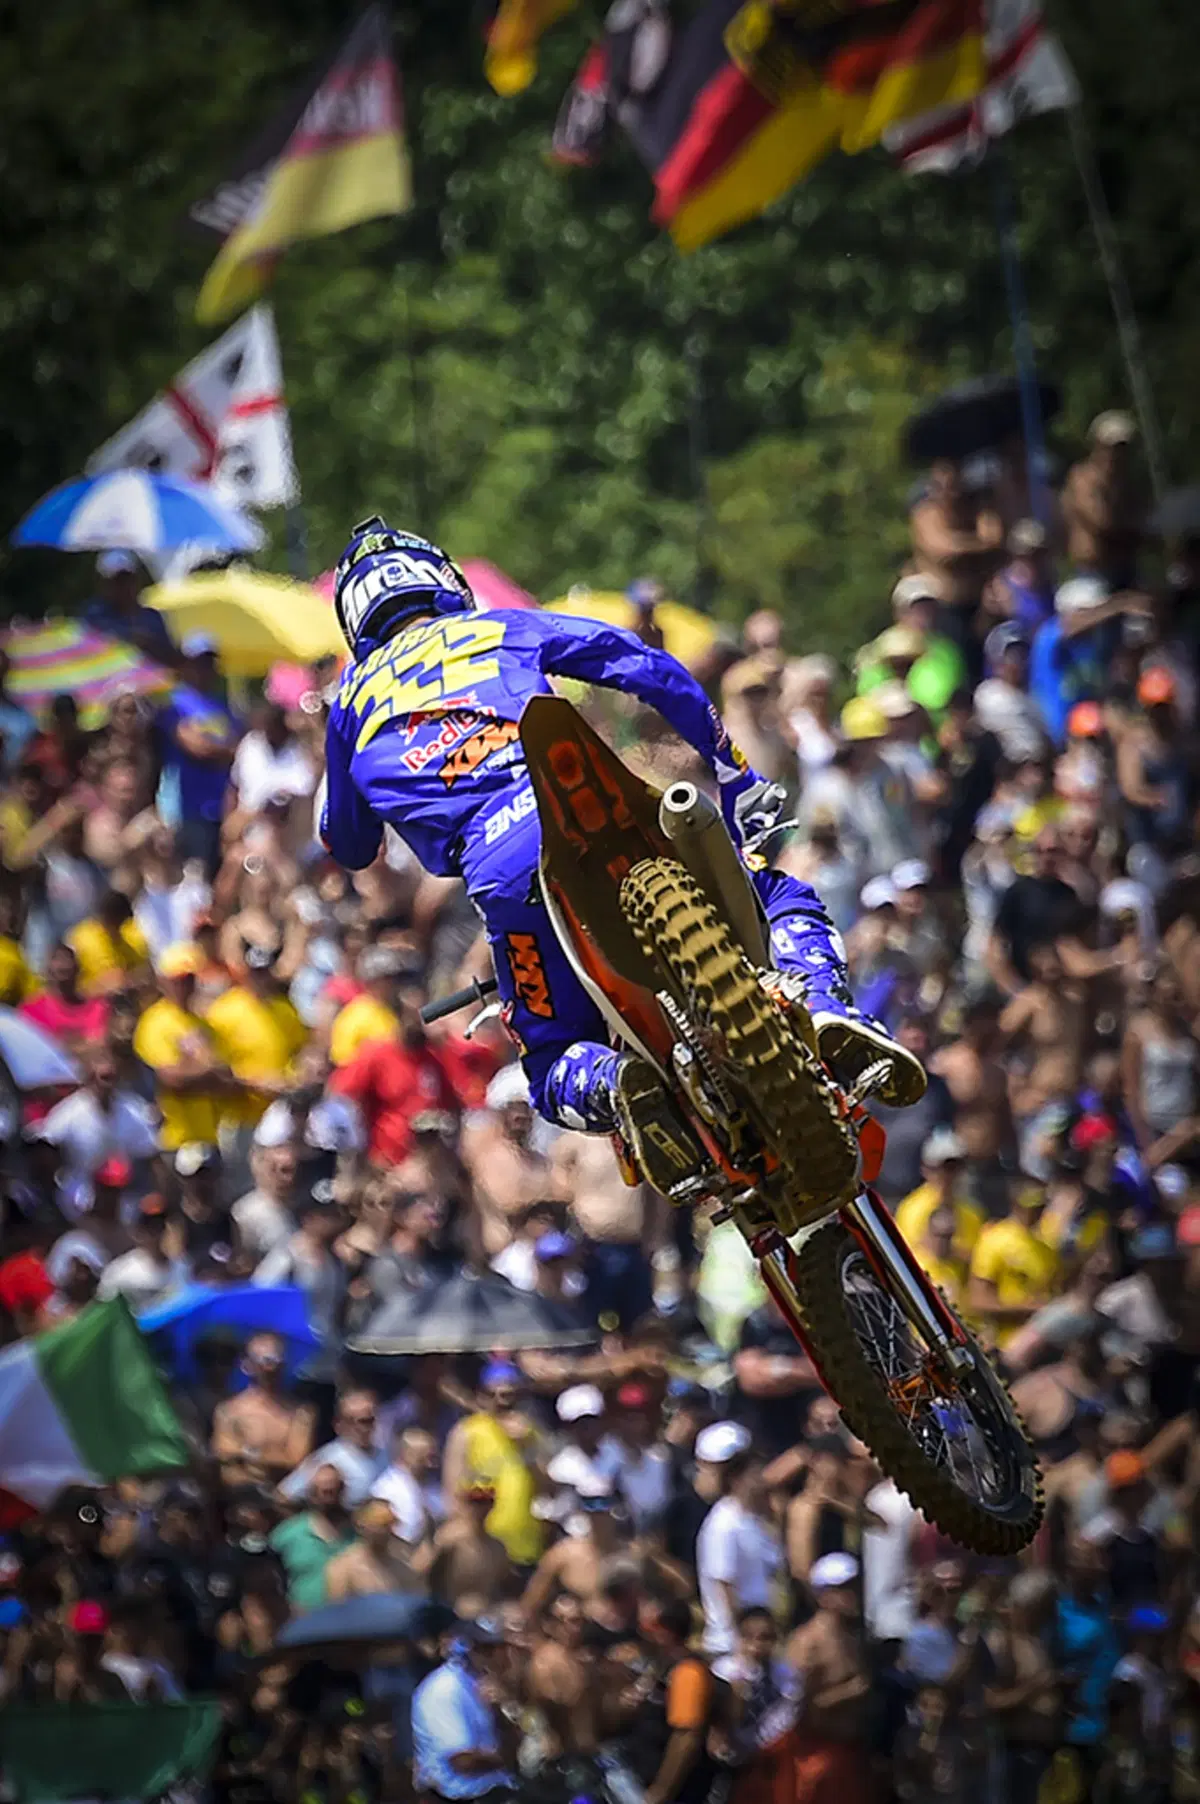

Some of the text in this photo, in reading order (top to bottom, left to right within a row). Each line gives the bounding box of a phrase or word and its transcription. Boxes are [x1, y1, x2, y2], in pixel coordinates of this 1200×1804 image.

[401, 718, 460, 774] Red
[438, 720, 520, 790] KTM
[507, 932, 554, 1018] KTM
